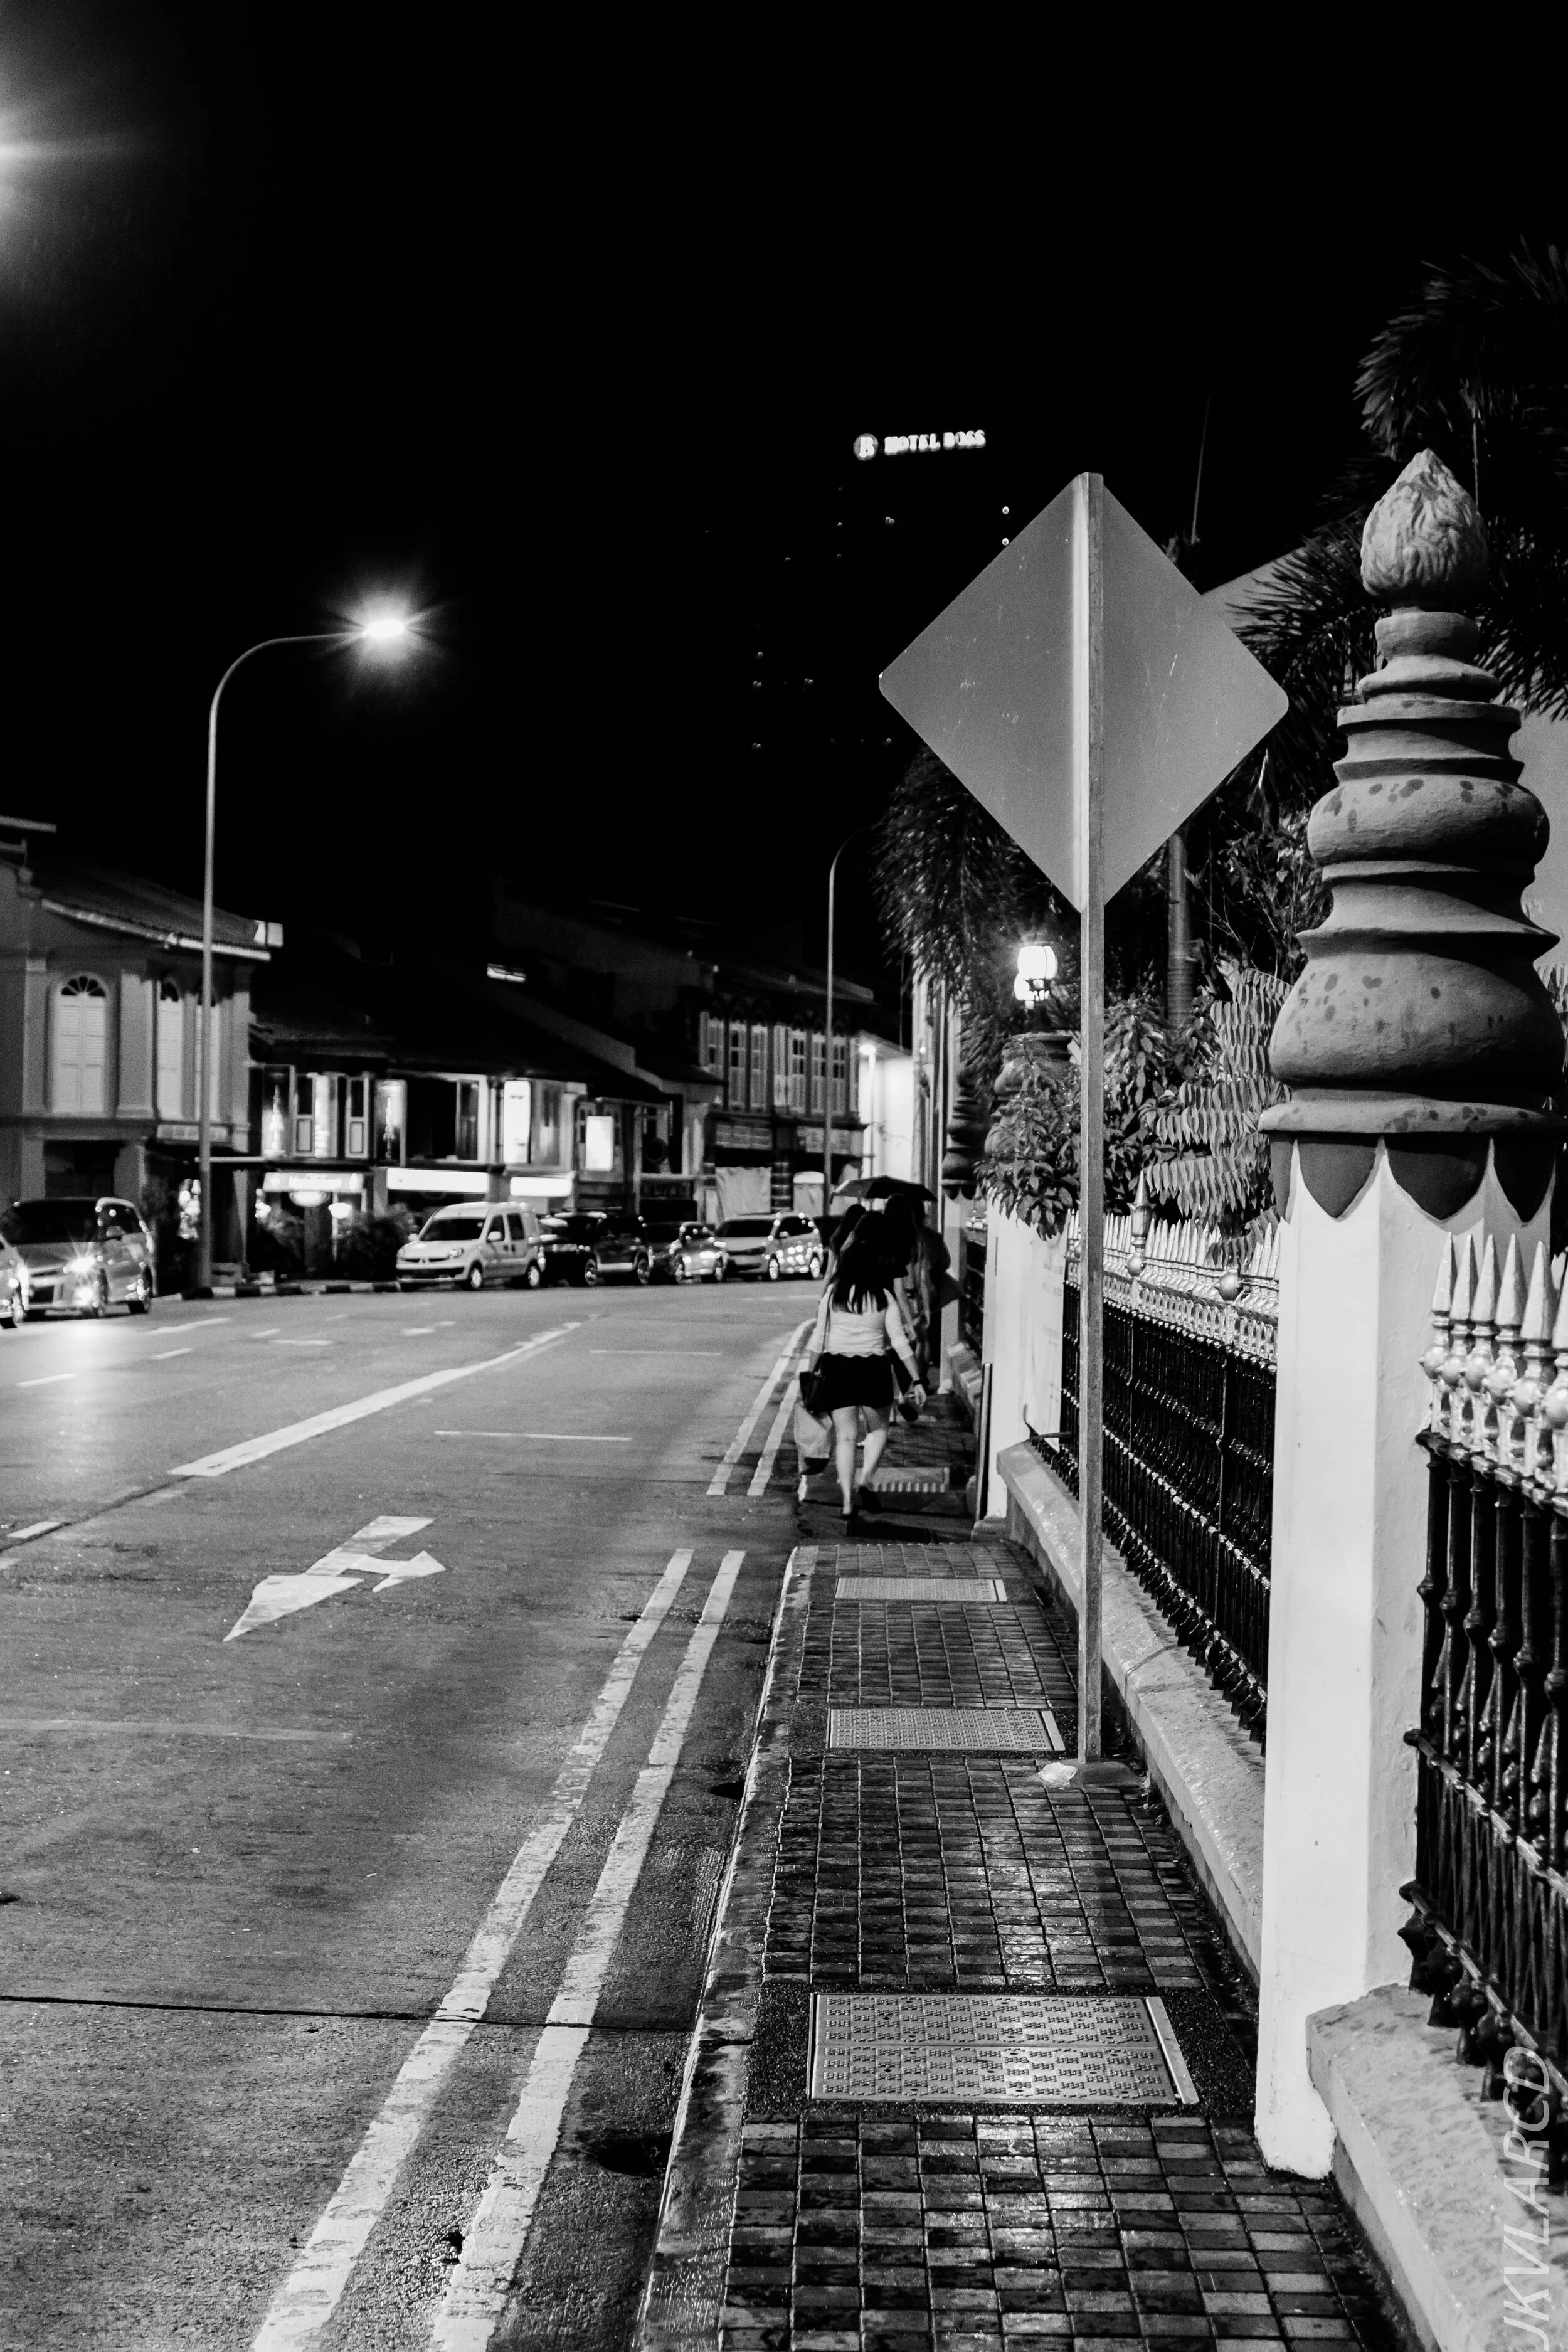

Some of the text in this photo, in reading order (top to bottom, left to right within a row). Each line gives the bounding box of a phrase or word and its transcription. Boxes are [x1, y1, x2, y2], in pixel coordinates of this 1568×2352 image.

[858, 429, 986, 458] B HOTEL BOSS
